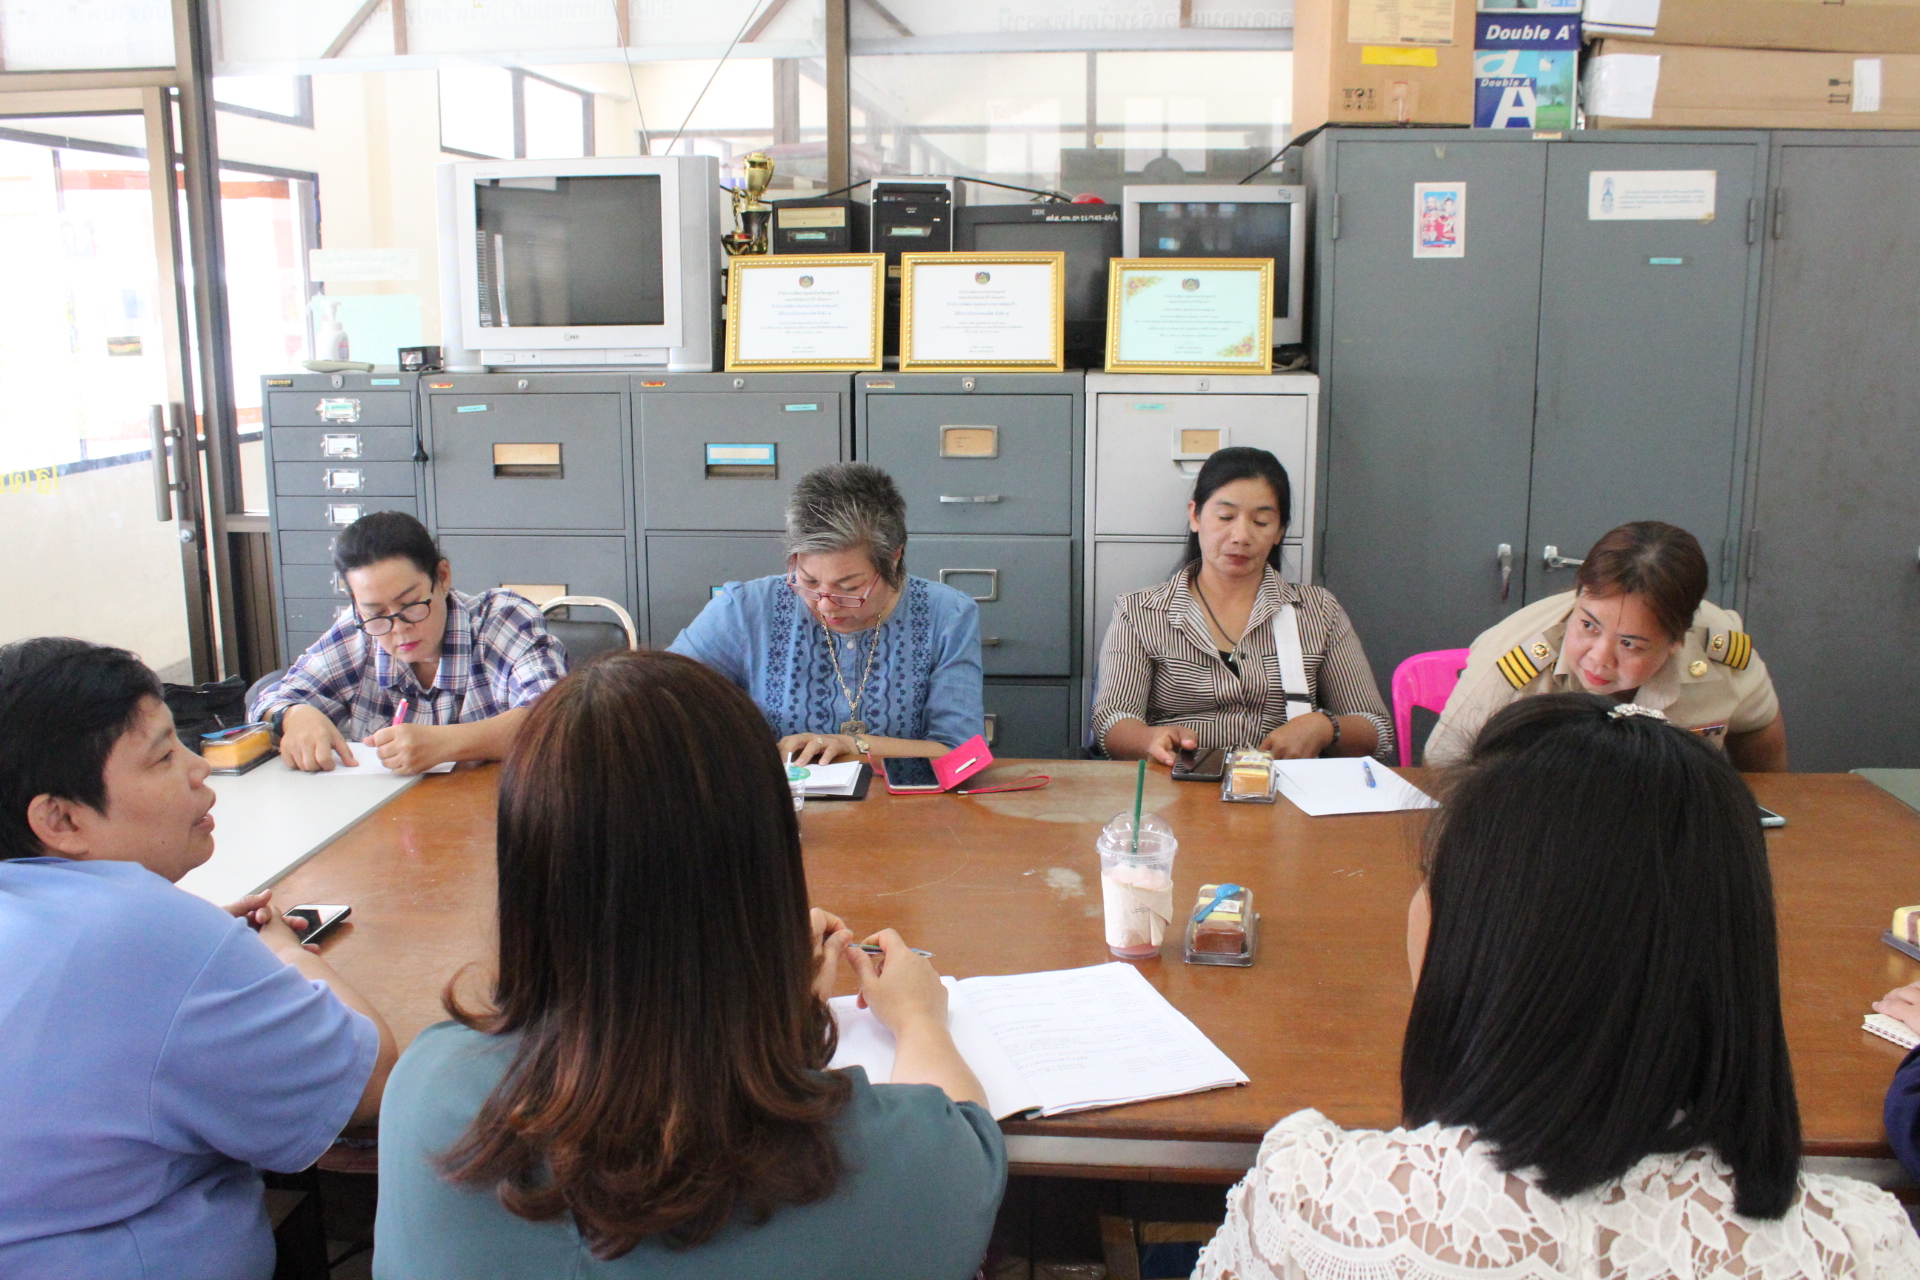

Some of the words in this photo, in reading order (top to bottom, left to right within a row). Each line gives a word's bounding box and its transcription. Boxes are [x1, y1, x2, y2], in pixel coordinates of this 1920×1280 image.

[1485, 24, 1551, 41] Double
[1555, 24, 1569, 40] A
[1480, 78, 1519, 87] Double
